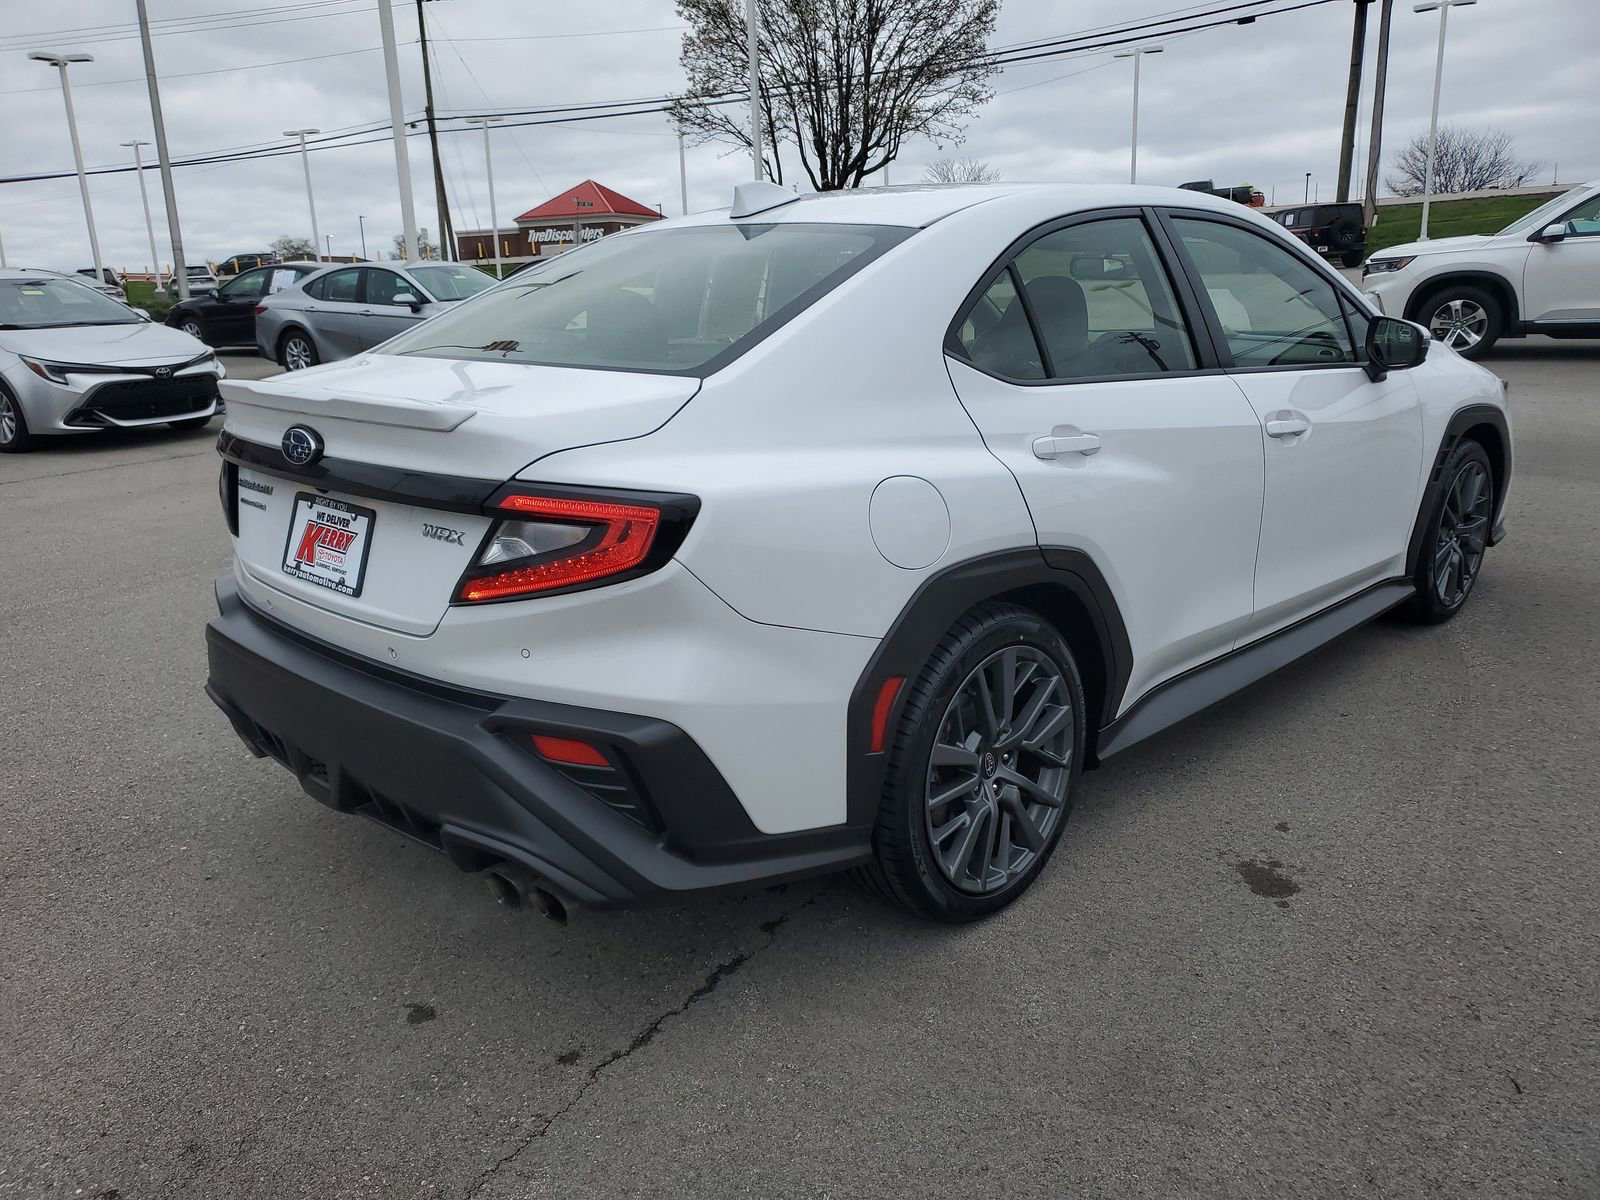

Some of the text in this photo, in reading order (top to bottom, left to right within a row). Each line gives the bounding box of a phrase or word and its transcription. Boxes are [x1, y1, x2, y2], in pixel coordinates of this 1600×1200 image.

[528, 227, 604, 242] TireDisconters
[330, 500, 338, 509] BY
[337, 501, 349, 512] YOU
[316, 511, 351, 529] WE DELIVER
[295, 521, 356, 566] KERRY
[422, 523, 466, 547] WRX
[324, 552, 343, 564] TOYOTA
[284, 564, 354, 596] kerryautomotive.com
